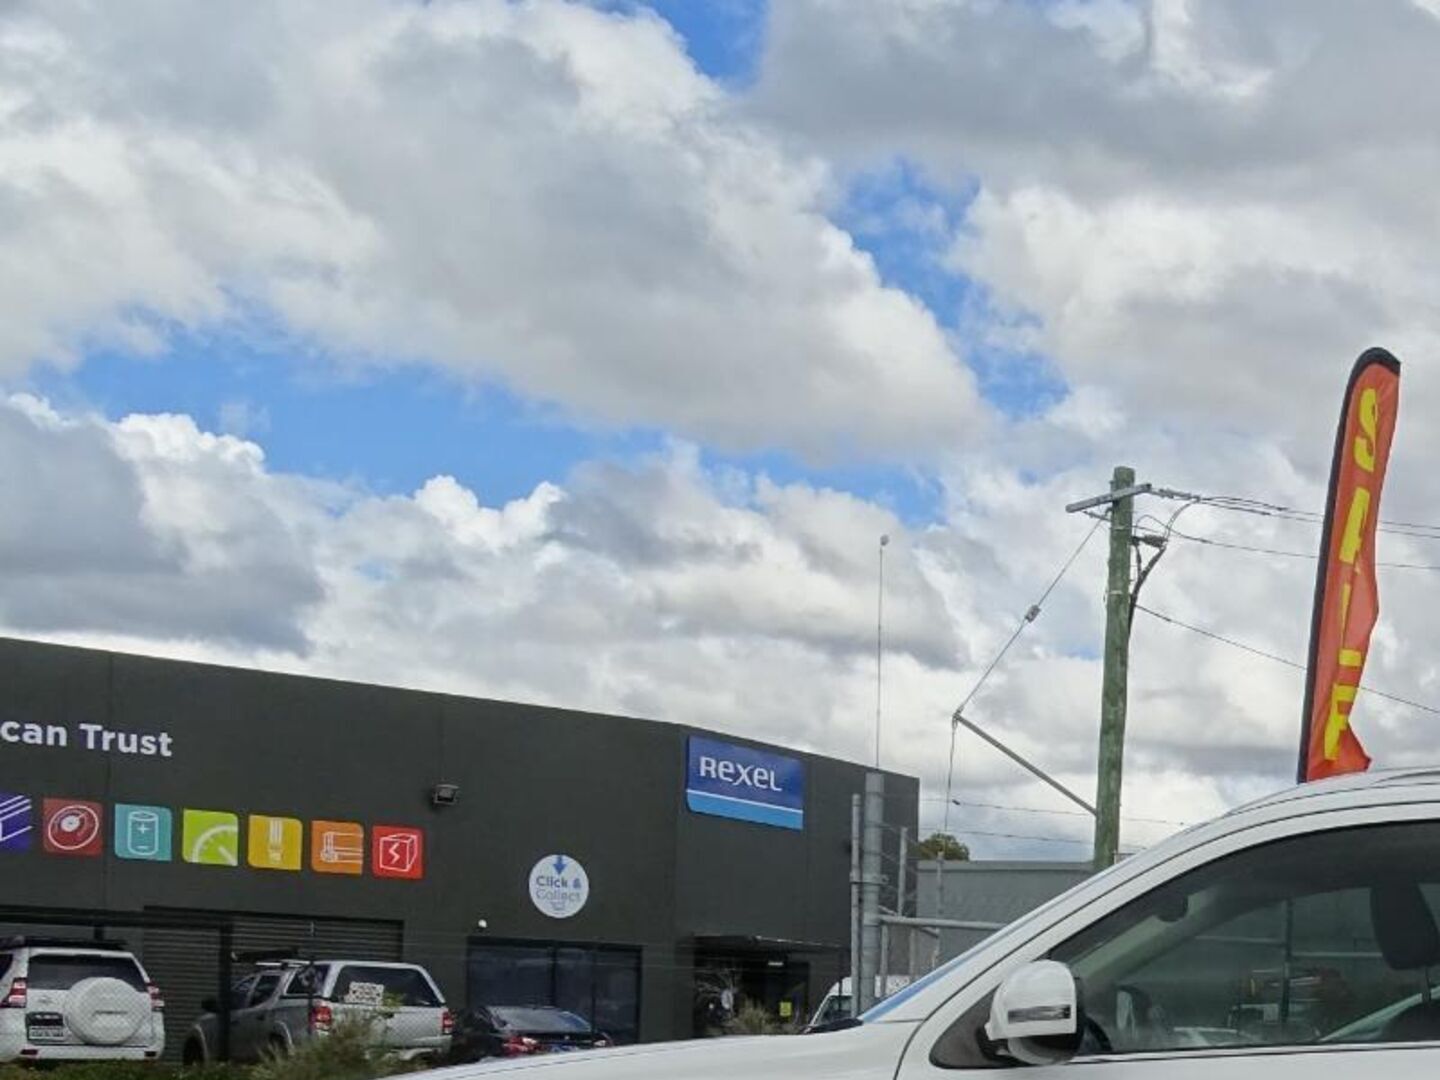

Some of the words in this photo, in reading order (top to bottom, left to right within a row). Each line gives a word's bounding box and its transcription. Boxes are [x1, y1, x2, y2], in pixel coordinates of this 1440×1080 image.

[0, 720, 68, 747] can
[79, 722, 173, 757] Trust
[536, 875, 568, 888] Click
[573, 877, 582, 889] &
[536, 888, 581, 902] Collect
